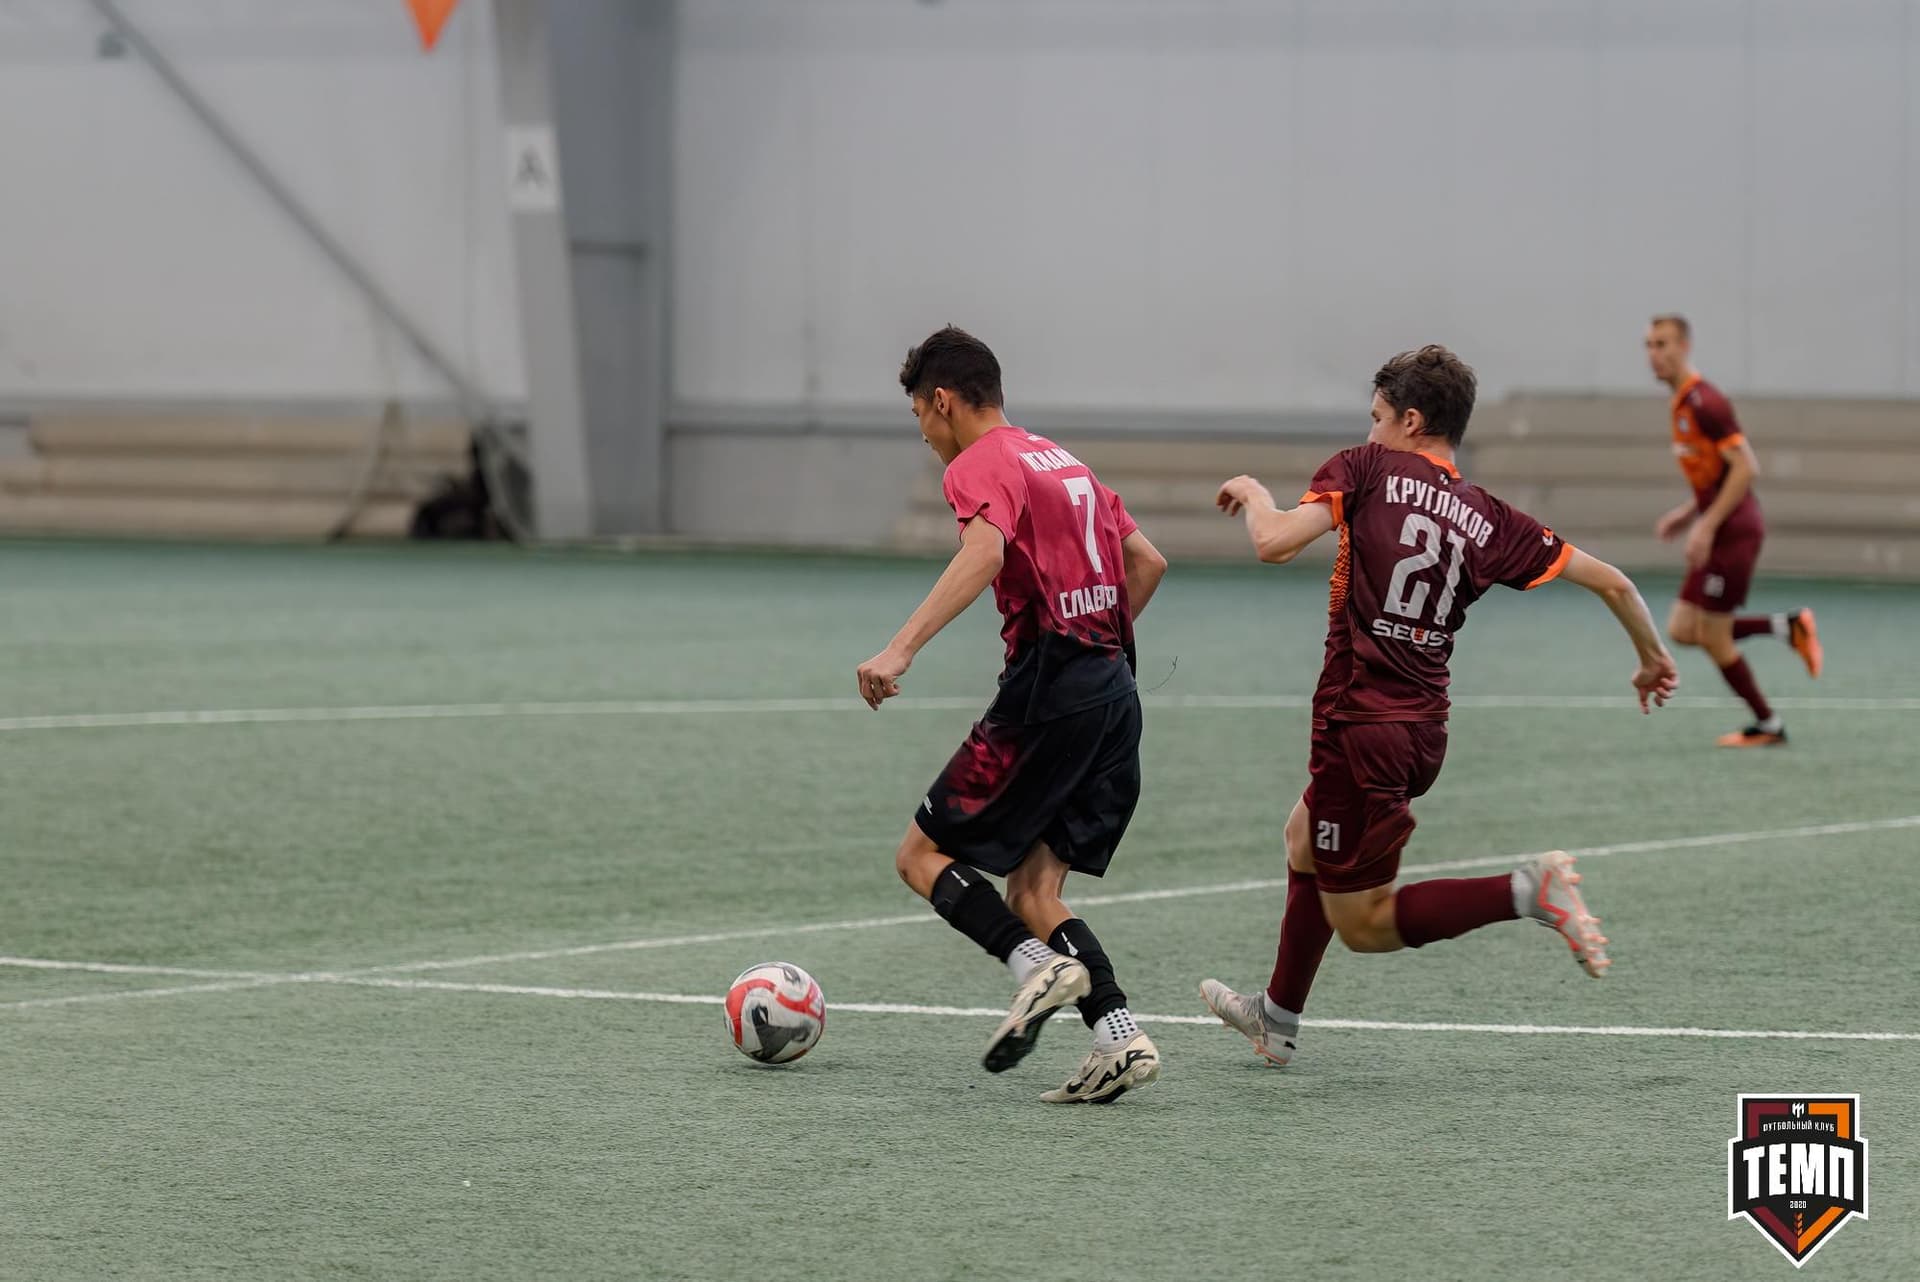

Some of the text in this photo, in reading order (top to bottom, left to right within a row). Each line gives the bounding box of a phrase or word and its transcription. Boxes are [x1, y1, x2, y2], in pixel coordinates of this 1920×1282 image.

[1062, 476, 1102, 573] 7
[1383, 513, 1466, 626] 21
[1371, 618, 1449, 647] SEUS
[1316, 820, 1340, 851] 21
